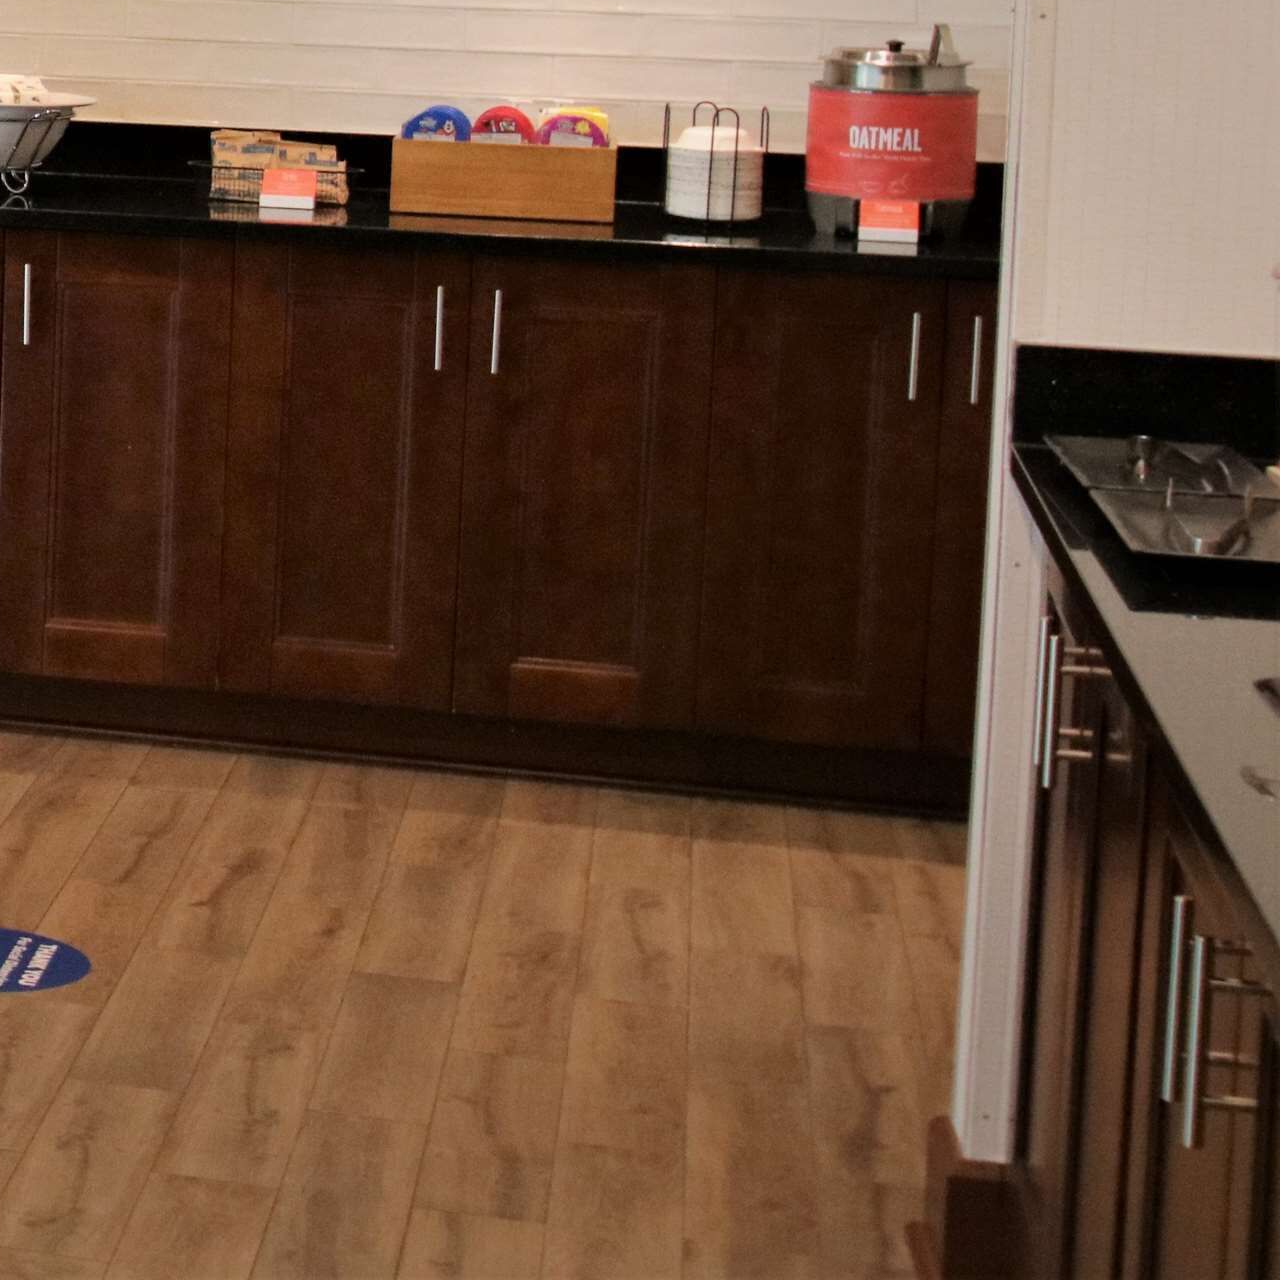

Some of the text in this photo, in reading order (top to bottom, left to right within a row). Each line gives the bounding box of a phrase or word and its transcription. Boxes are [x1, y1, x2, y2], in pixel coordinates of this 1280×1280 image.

[849, 125, 922, 152] OATMEAL
[18, 944, 59, 986] THANK YOU
